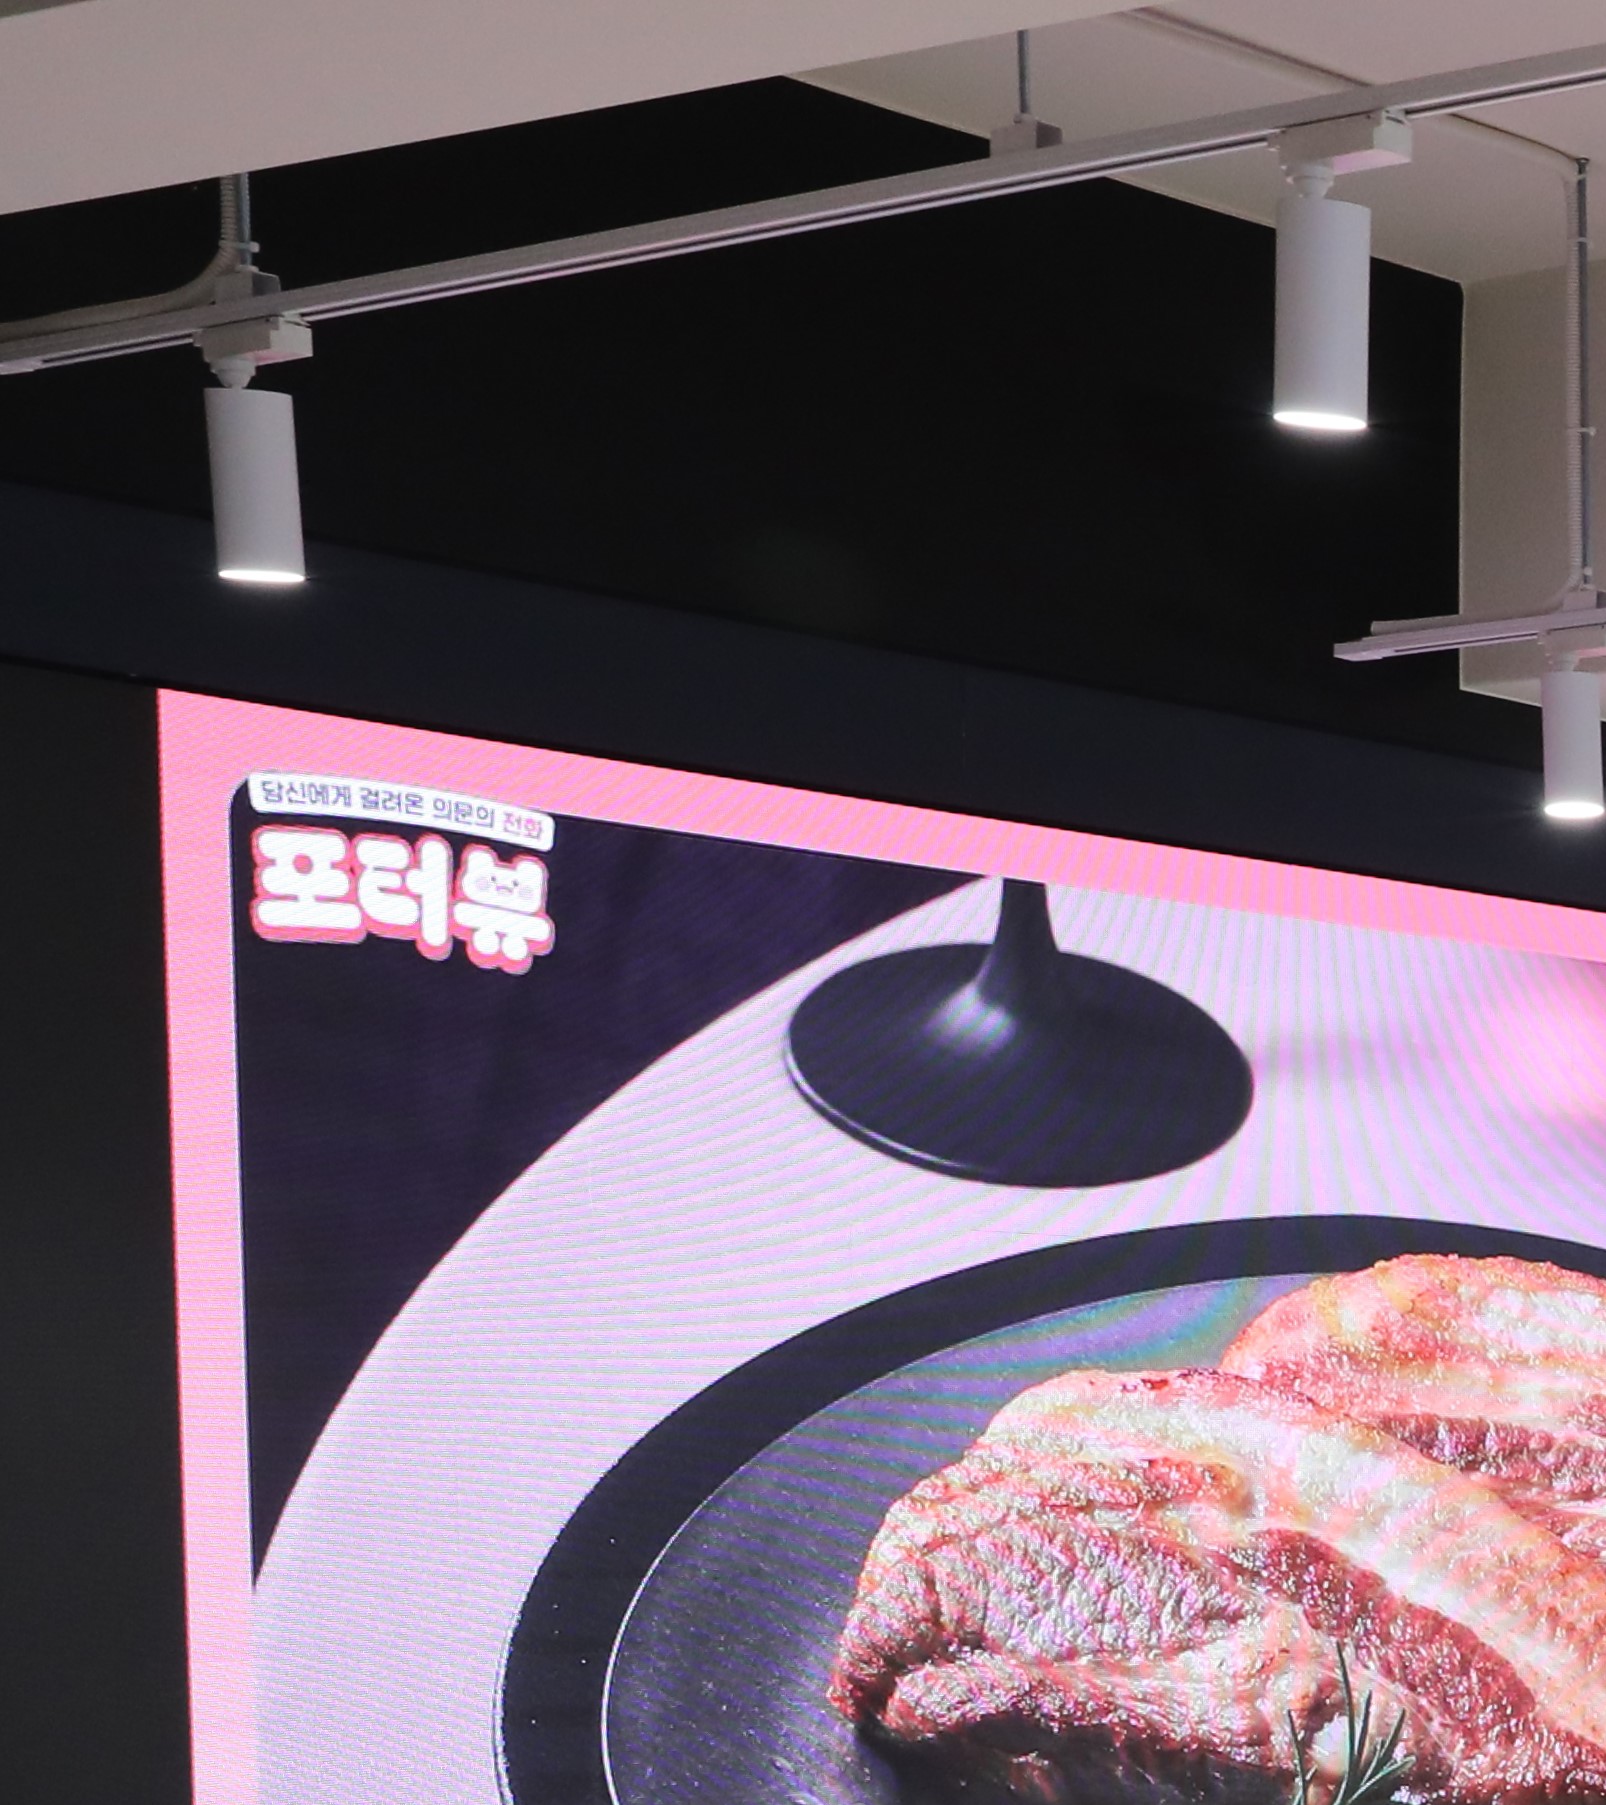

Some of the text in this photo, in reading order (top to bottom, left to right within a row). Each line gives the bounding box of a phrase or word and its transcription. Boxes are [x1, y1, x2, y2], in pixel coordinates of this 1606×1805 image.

[261, 780, 542, 840] 당신에게 걸려온 의문의 전화
[253, 825, 555, 973] 포터뷰
